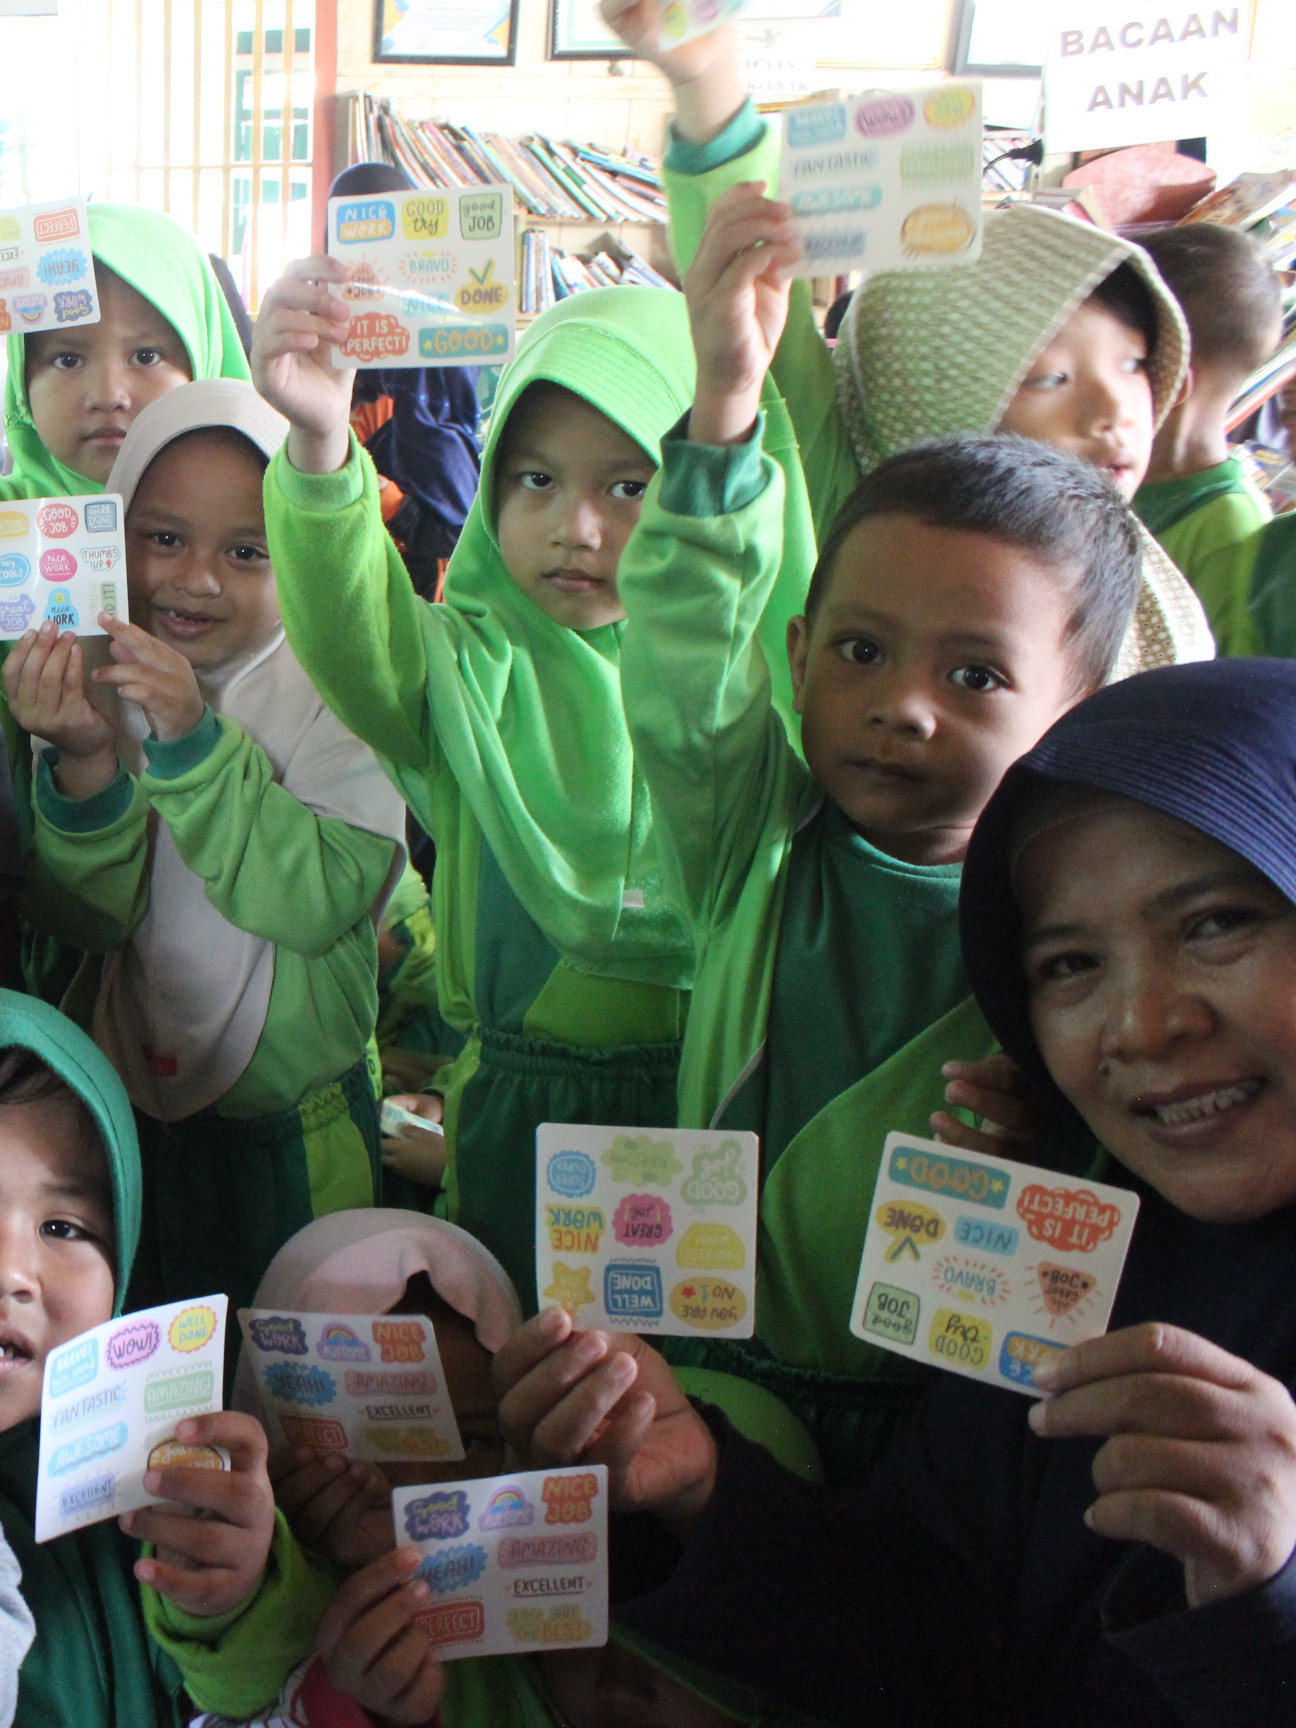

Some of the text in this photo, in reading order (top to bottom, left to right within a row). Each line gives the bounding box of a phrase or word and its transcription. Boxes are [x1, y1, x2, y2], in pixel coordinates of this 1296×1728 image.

[1060, 8, 1239, 57] BACAAN
[1086, 71, 1209, 112] ANAK
[345, 205, 387, 221] NICE
[406, 201, 444, 217] GOOD
[463, 201, 495, 216] good
[39, 218, 75, 235] PERFECT
[342, 223, 387, 238] WORK
[413, 216, 439, 235] try
[468, 216, 495, 232] JOB
[44, 258, 79, 276] YEAH!
[410, 259, 449, 273] BRAVO
[59, 295, 86, 307] WORK
[461, 287, 503, 305] DONE
[357, 320, 389, 334] IT IS
[346, 335, 407, 352] PERFECT!
[433, 328, 494, 355] GOOD
[43, 507, 71, 520] GOOD
[89, 504, 112, 515] well
[49, 523, 68, 533] JOB
[89, 514, 113, 526] DONE
[83, 549, 119, 559] THUMBS
[0, 560, 15, 568] very
[44, 563, 71, 572] WORK
[93, 560, 104, 569] UP
[5, 616, 24, 627] JOB
[909, 1156, 990, 1201] GOOD
[1023, 1190, 1113, 1228] PERFECT!
[549, 1208, 603, 1230] WORK
[884, 1206, 940, 1238] DONE
[623, 1224, 663, 1239] GREAT
[960, 1224, 1012, 1250] NICE
[1043, 1218, 1090, 1245] IT IS
[554, 1230, 600, 1251] NICE
[612, 1275, 653, 1290] DONE
[944, 1266, 998, 1296] BRAVO
[1050, 1270, 1081, 1289] JOB
[713, 1285, 735, 1299] NO
[616, 1295, 654, 1308] WELL
[876, 1292, 910, 1319] JOB
[682, 1305, 737, 1321] YOU ARE
[179, 1316, 205, 1329] WELL
[871, 1312, 914, 1336] good
[946, 1313, 980, 1344] try
[179, 1328, 207, 1344] DONE
[262, 1333, 303, 1349] WORK
[376, 1326, 420, 1340] NICE
[113, 1332, 154, 1360] WOW!
[385, 1345, 421, 1362] JOB
[935, 1336, 984, 1366] GOOD
[147, 1377, 213, 1403] AMAZING!
[53, 1384, 121, 1429] FANTASTIC
[366, 1405, 432, 1416] EXCELLENT
[56, 1426, 121, 1467] AWESOME
[546, 1479, 596, 1496] NICE
[547, 1502, 590, 1521] JOB
[510, 1538, 589, 1559] AMAZING
[513, 1577, 585, 1594] EXCELLENT
